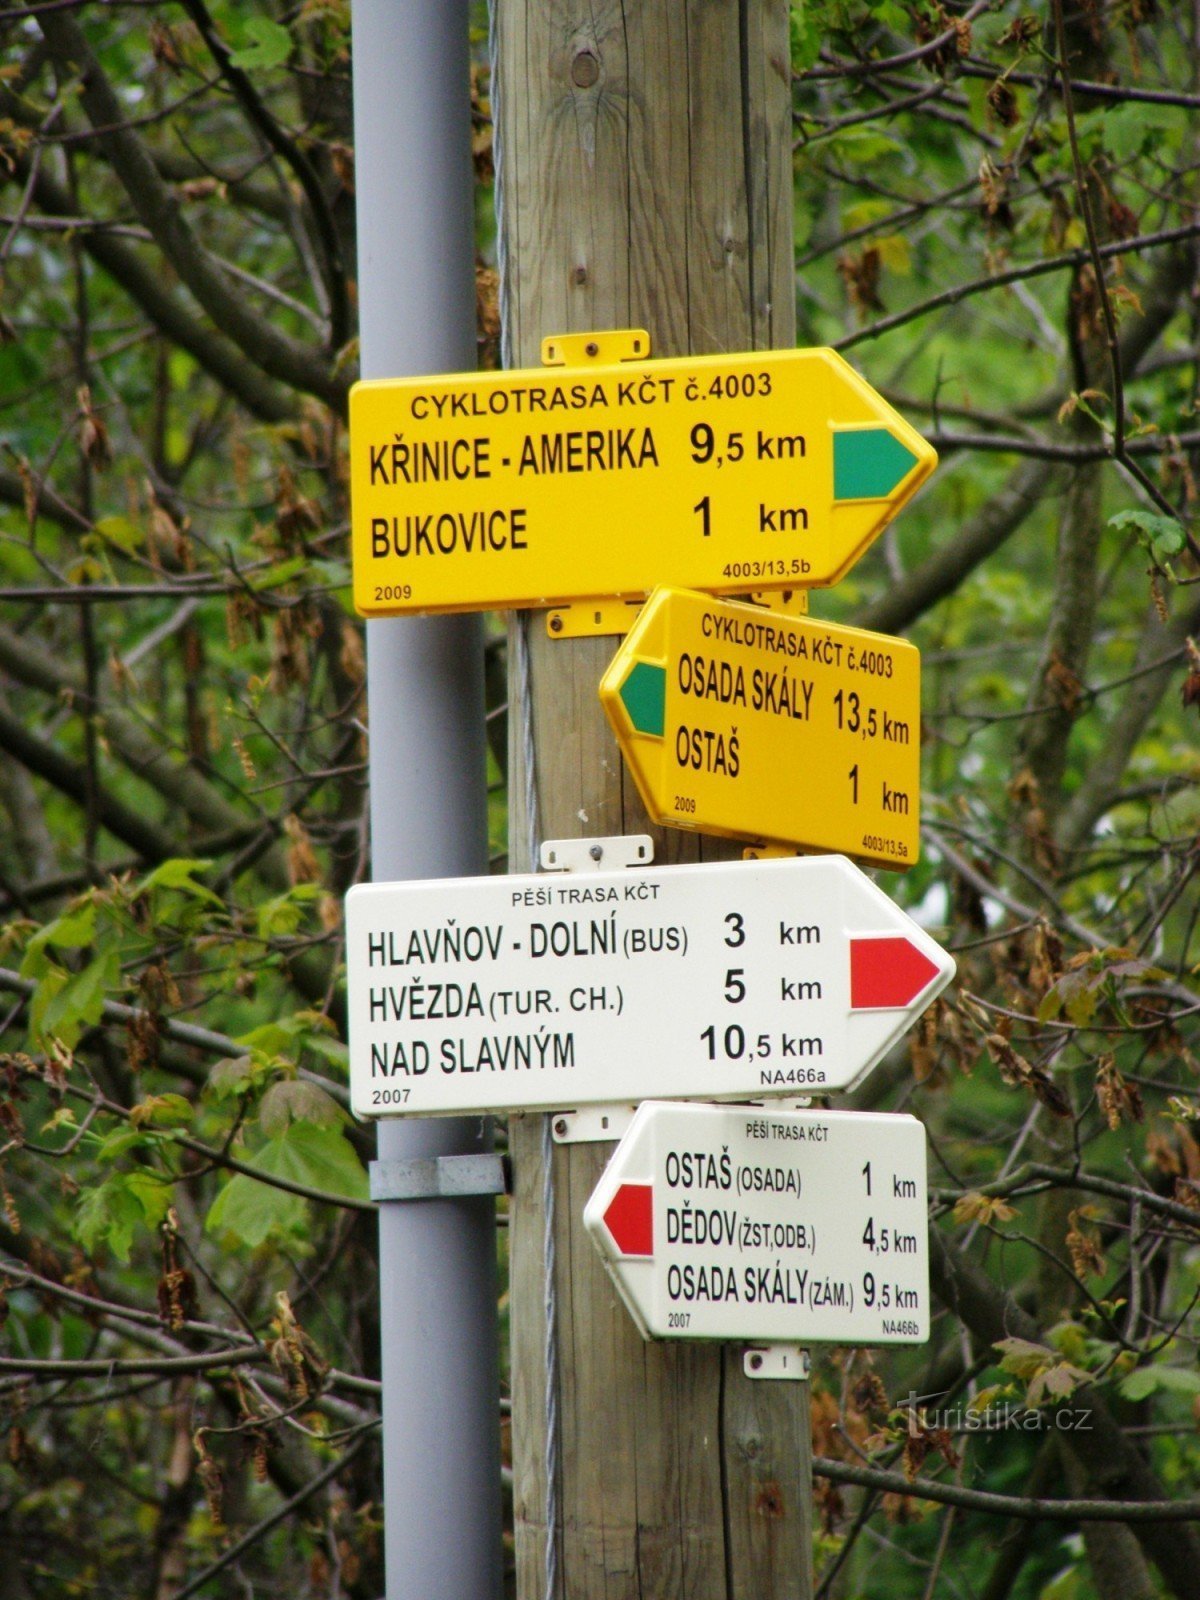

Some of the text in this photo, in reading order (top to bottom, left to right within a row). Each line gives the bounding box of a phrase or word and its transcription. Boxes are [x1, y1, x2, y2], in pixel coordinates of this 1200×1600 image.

[411, 373, 771, 419] CYKLOTRASA KČT č.4003
[371, 423, 805, 485] KŘINICE - AMERIKA 9,5 km
[372, 497, 808, 558] BUKOVICE 1 km
[722, 559, 811, 578] 4003/13,5b
[375, 585, 411, 601] 2009
[702, 613, 892, 678] CYKLOTRASA KČT č.4003
[679, 653, 908, 744] OSADA SKÁLY 13,5 km
[677, 726, 908, 814] OSTAŠ 1 km
[675, 796, 695, 813] 2009
[862, 834, 908, 857] 4003/13,5a
[513, 882, 659, 906] PĚŠÍ TRASA KČT
[369, 920, 502, 966] HLAVŇOV
[531, 910, 616, 957] DOLNÍ
[624, 927, 687, 959] (BUS)
[725, 913, 745, 947] 3
[780, 922, 820, 944] km
[570, 986, 623, 1015] CH.)
[725, 969, 745, 1003] 5
[782, 978, 821, 1000] km
[372, 1025, 822, 1077] NAD SLAVNÝM 10,5 km
[373, 1089, 410, 1104] 2007
[761, 1069, 825, 1084] NA466a
[747, 1122, 828, 1141] PĚŠÍ TRASA KČT
[666, 1146, 915, 1198] OSTAŠ (OSADA) 1 km
[667, 1200, 736, 1245] DĚDOV
[863, 1217, 888, 1255] 4,5
[895, 1230, 916, 1252] km
[668, 1260, 917, 1312] OSADA SKÁLY (ZÁM.) 9,5 km
[669, 1313, 690, 1328] 2007
[883, 1320, 918, 1335] NA466b
